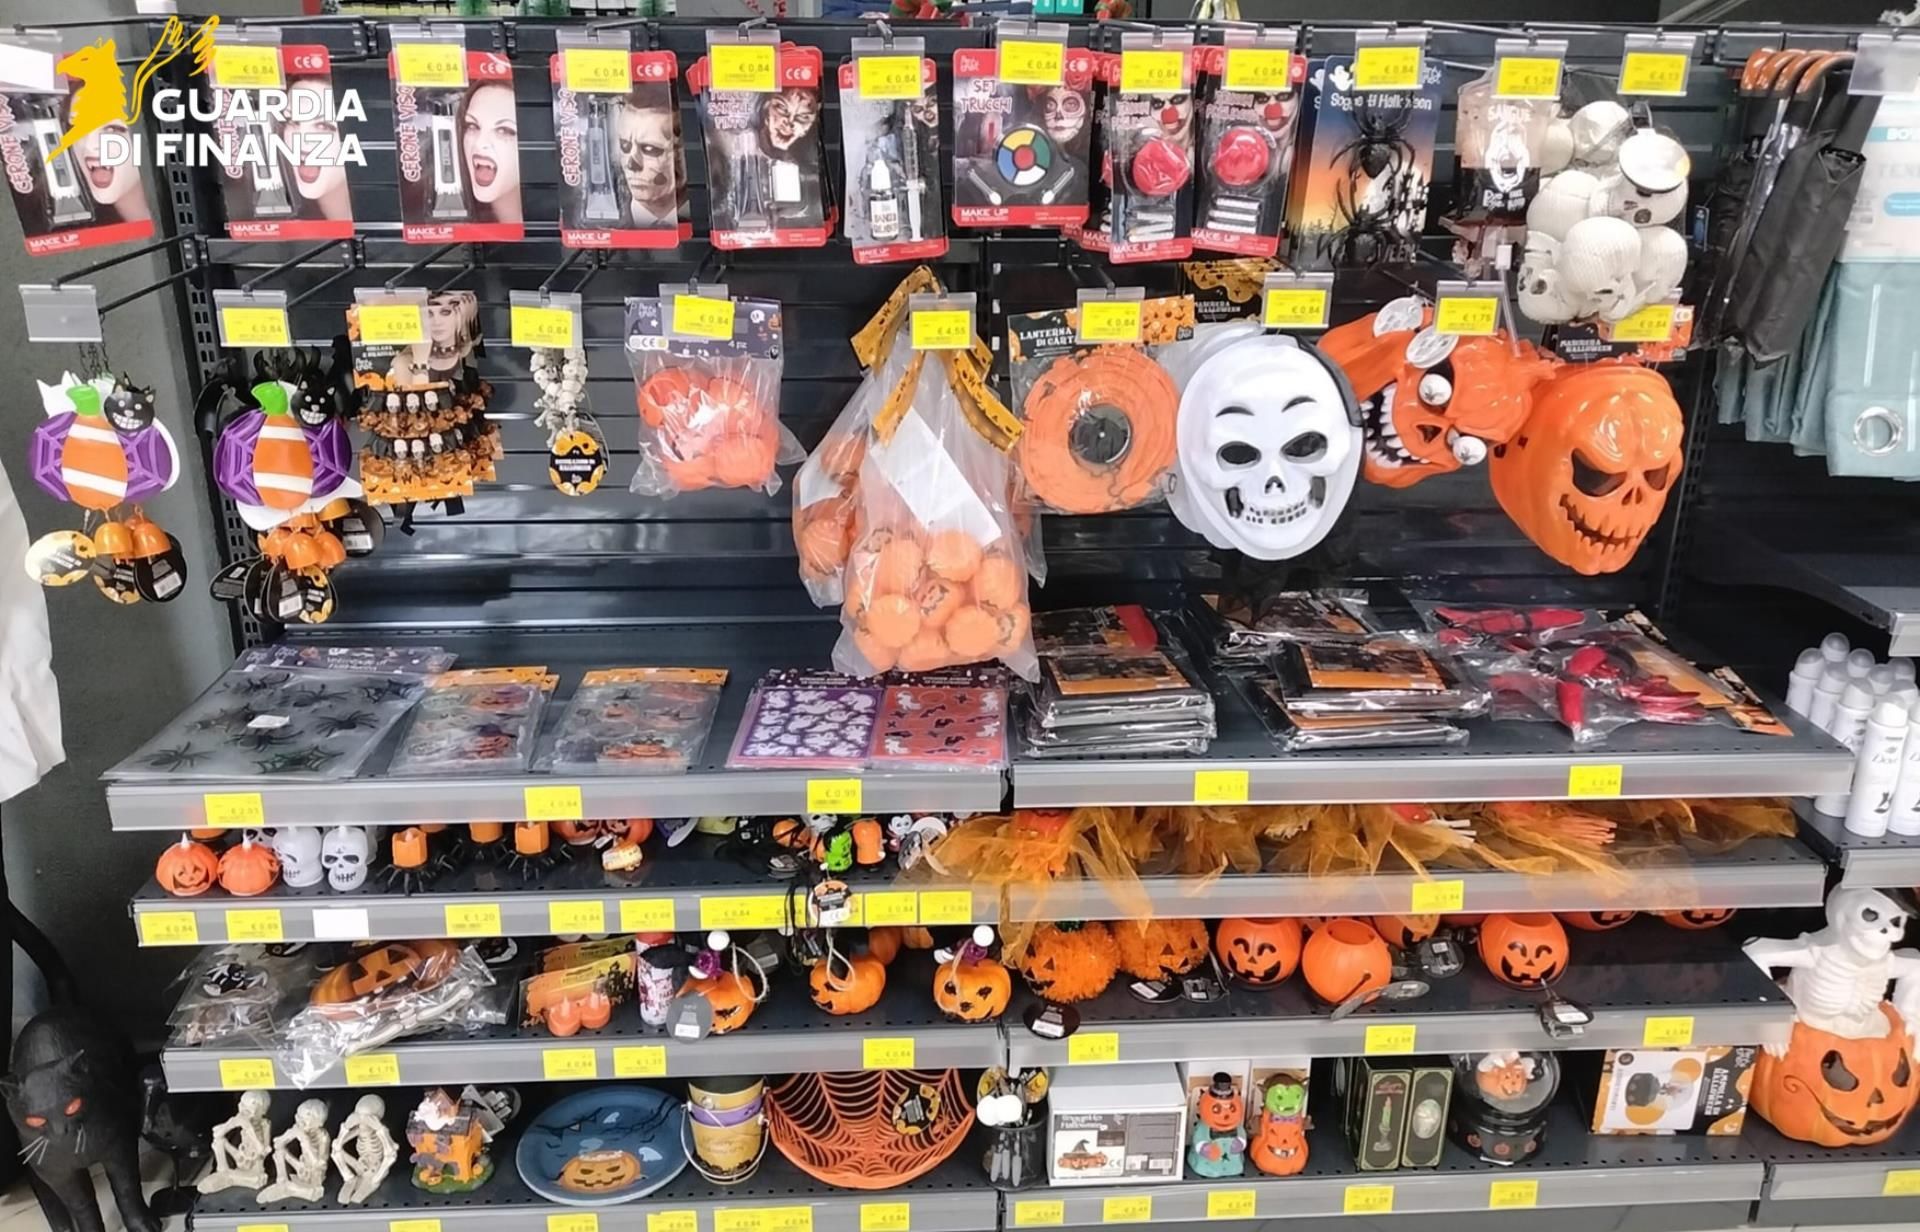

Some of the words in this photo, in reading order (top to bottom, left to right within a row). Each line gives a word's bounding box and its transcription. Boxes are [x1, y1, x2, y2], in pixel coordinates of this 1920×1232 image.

[973, 79, 997, 95] SET
[960, 96, 1012, 114] TRUCCHI
[961, 208, 990, 216] MAKE
[994, 208, 1008, 216] UP
[232, 224, 262, 232] MAKE
[264, 224, 280, 232] UP
[30, 236, 60, 247] MAKE
[63, 234, 79, 242] UP
[1226, 234, 1240, 242] UP
[1112, 244, 1139, 253] MAKE
[1143, 243, 1157, 251] UP
[1020, 327, 1072, 340] LANTERNA
[1036, 338, 1047, 348] DI
